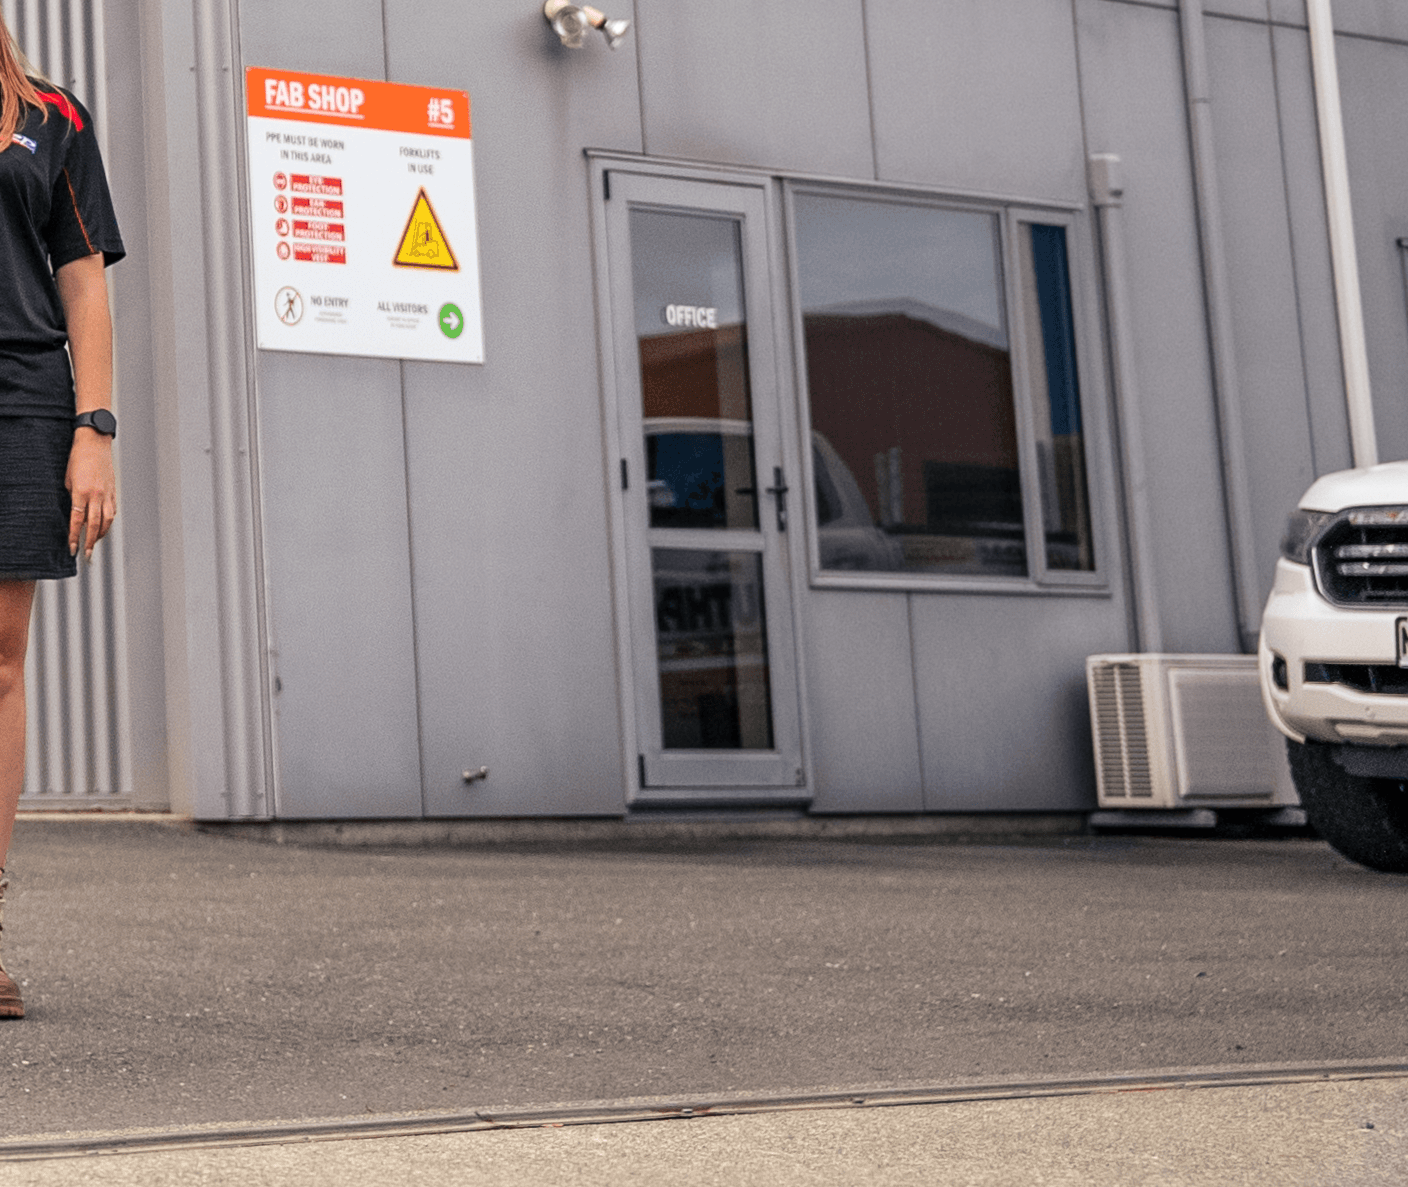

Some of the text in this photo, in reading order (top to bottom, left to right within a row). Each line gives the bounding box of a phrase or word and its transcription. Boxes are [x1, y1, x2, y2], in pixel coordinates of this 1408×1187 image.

[264, 78, 365, 113] FAB SHOP
[427, 97, 454, 124] #5
[266, 131, 345, 151] PPE MUST BE WORN
[280, 150, 332, 165] IN THIS AREA
[399, 146, 441, 161] FORKLIFTS
[417, 164, 434, 175] USE
[310, 295, 349, 309] NO ENTRY
[377, 300, 428, 314] ALL VISITORS
[666, 304, 717, 329] OFFICE
